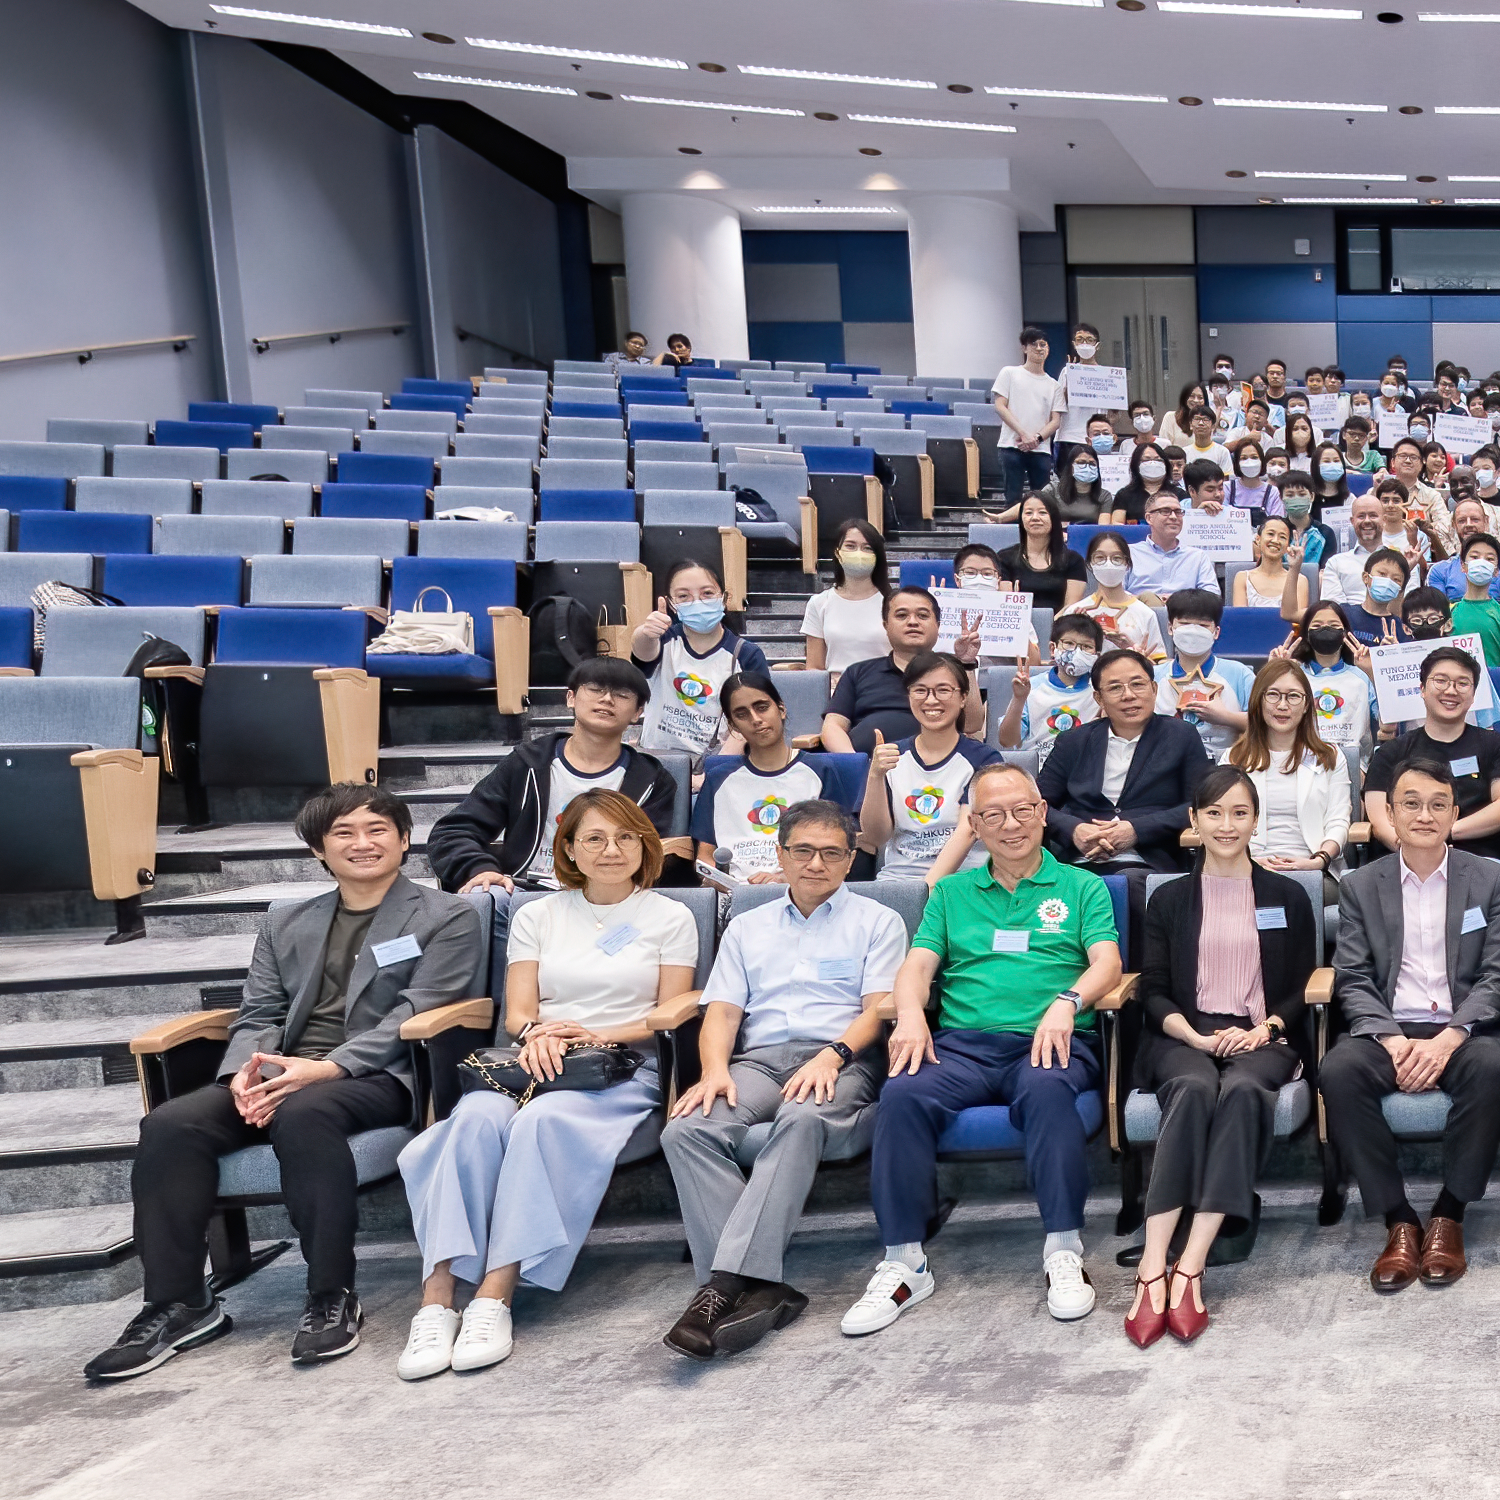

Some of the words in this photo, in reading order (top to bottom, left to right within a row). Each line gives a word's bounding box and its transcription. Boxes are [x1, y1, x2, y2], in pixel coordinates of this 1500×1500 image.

[1005, 595, 1026, 603] F08
[1452, 637, 1474, 648] F07
[1380, 666, 1405, 675] FUNG
